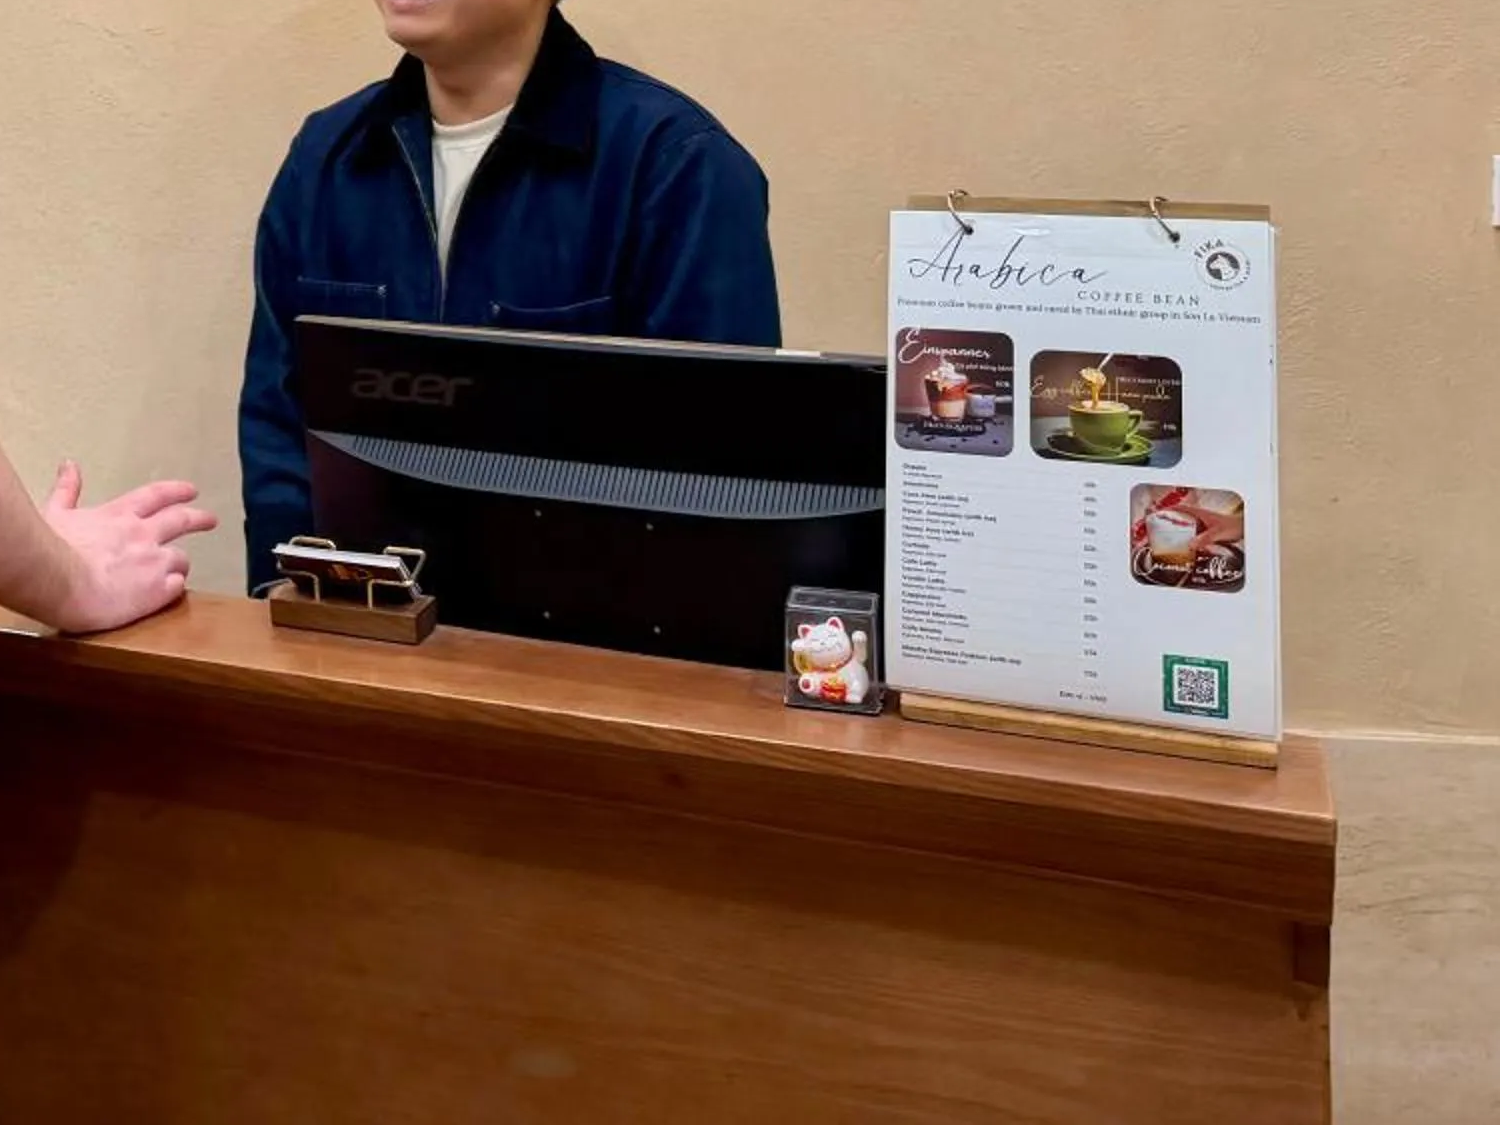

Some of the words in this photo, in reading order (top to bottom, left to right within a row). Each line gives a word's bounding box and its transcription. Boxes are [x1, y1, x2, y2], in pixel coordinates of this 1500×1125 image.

[906, 226, 1109, 289] Arabica
[1077, 290, 1144, 304] COFFEE
[1153, 294, 1200, 307] BEAN
[350, 368, 474, 407] acer
